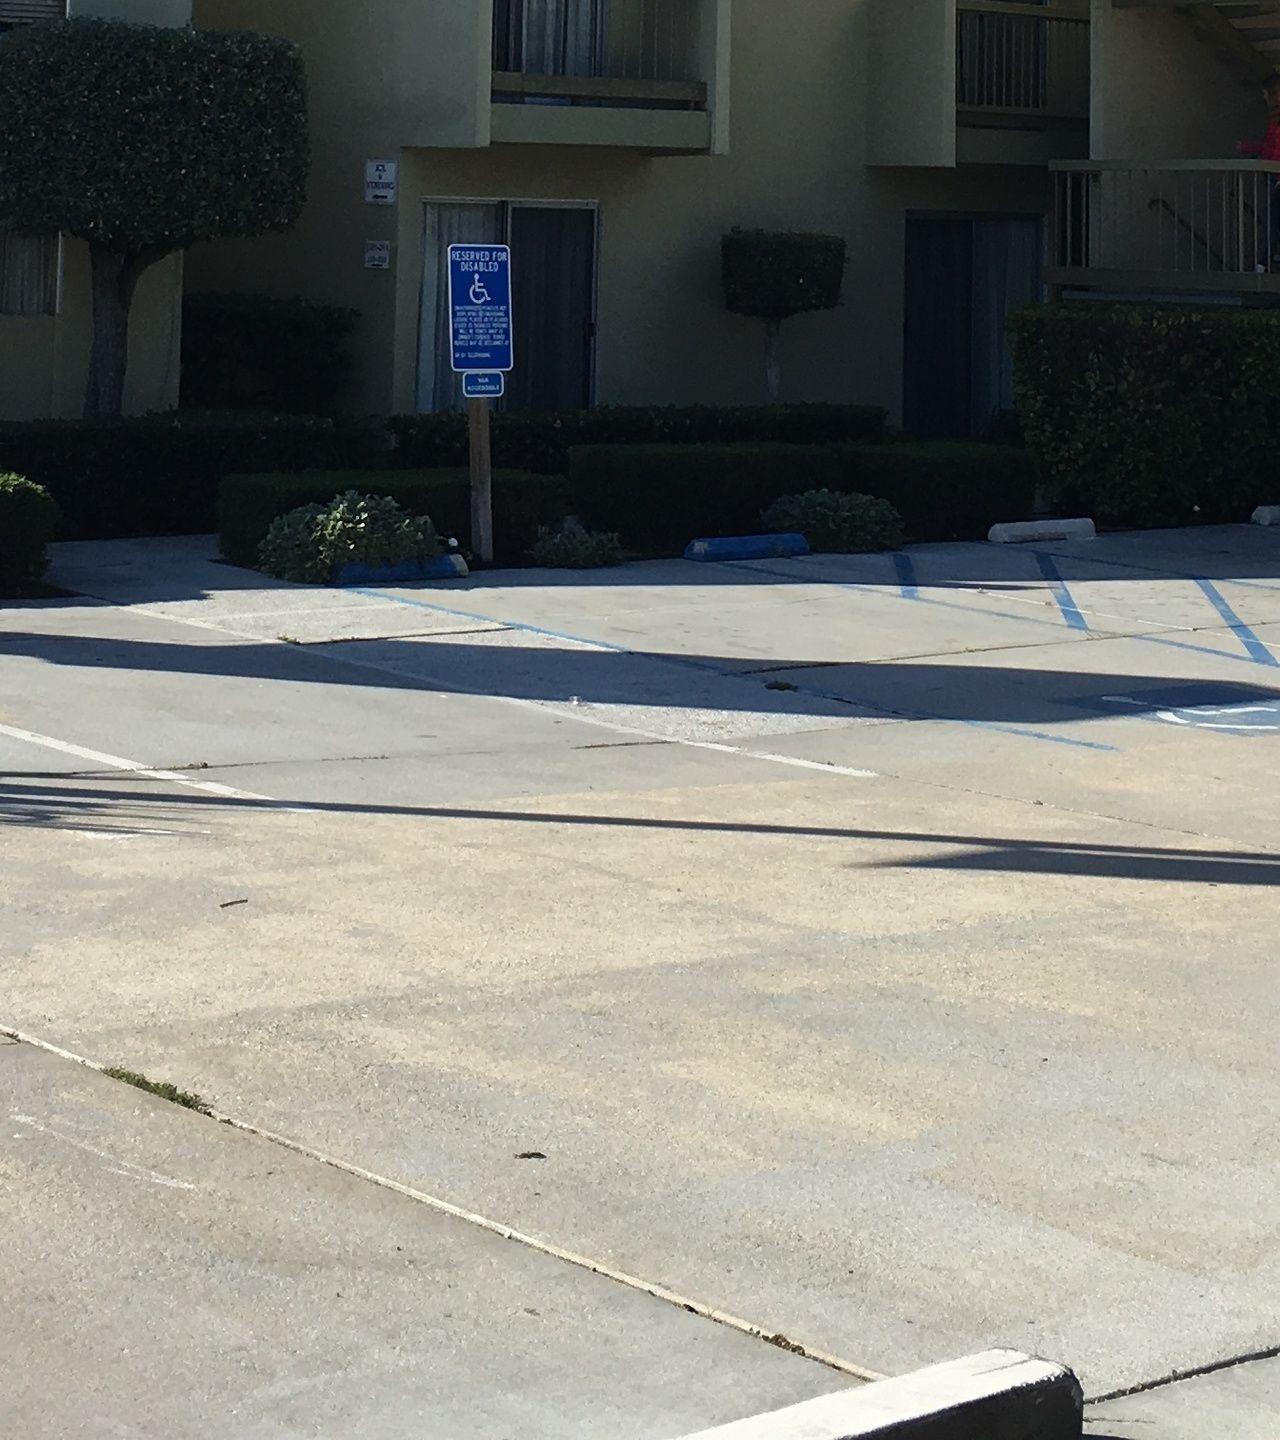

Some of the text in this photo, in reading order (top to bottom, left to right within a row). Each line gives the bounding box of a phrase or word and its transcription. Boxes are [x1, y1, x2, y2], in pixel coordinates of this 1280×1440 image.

[451, 251, 507, 262] RESERVED FOR
[460, 262, 499, 272] DISABLED
